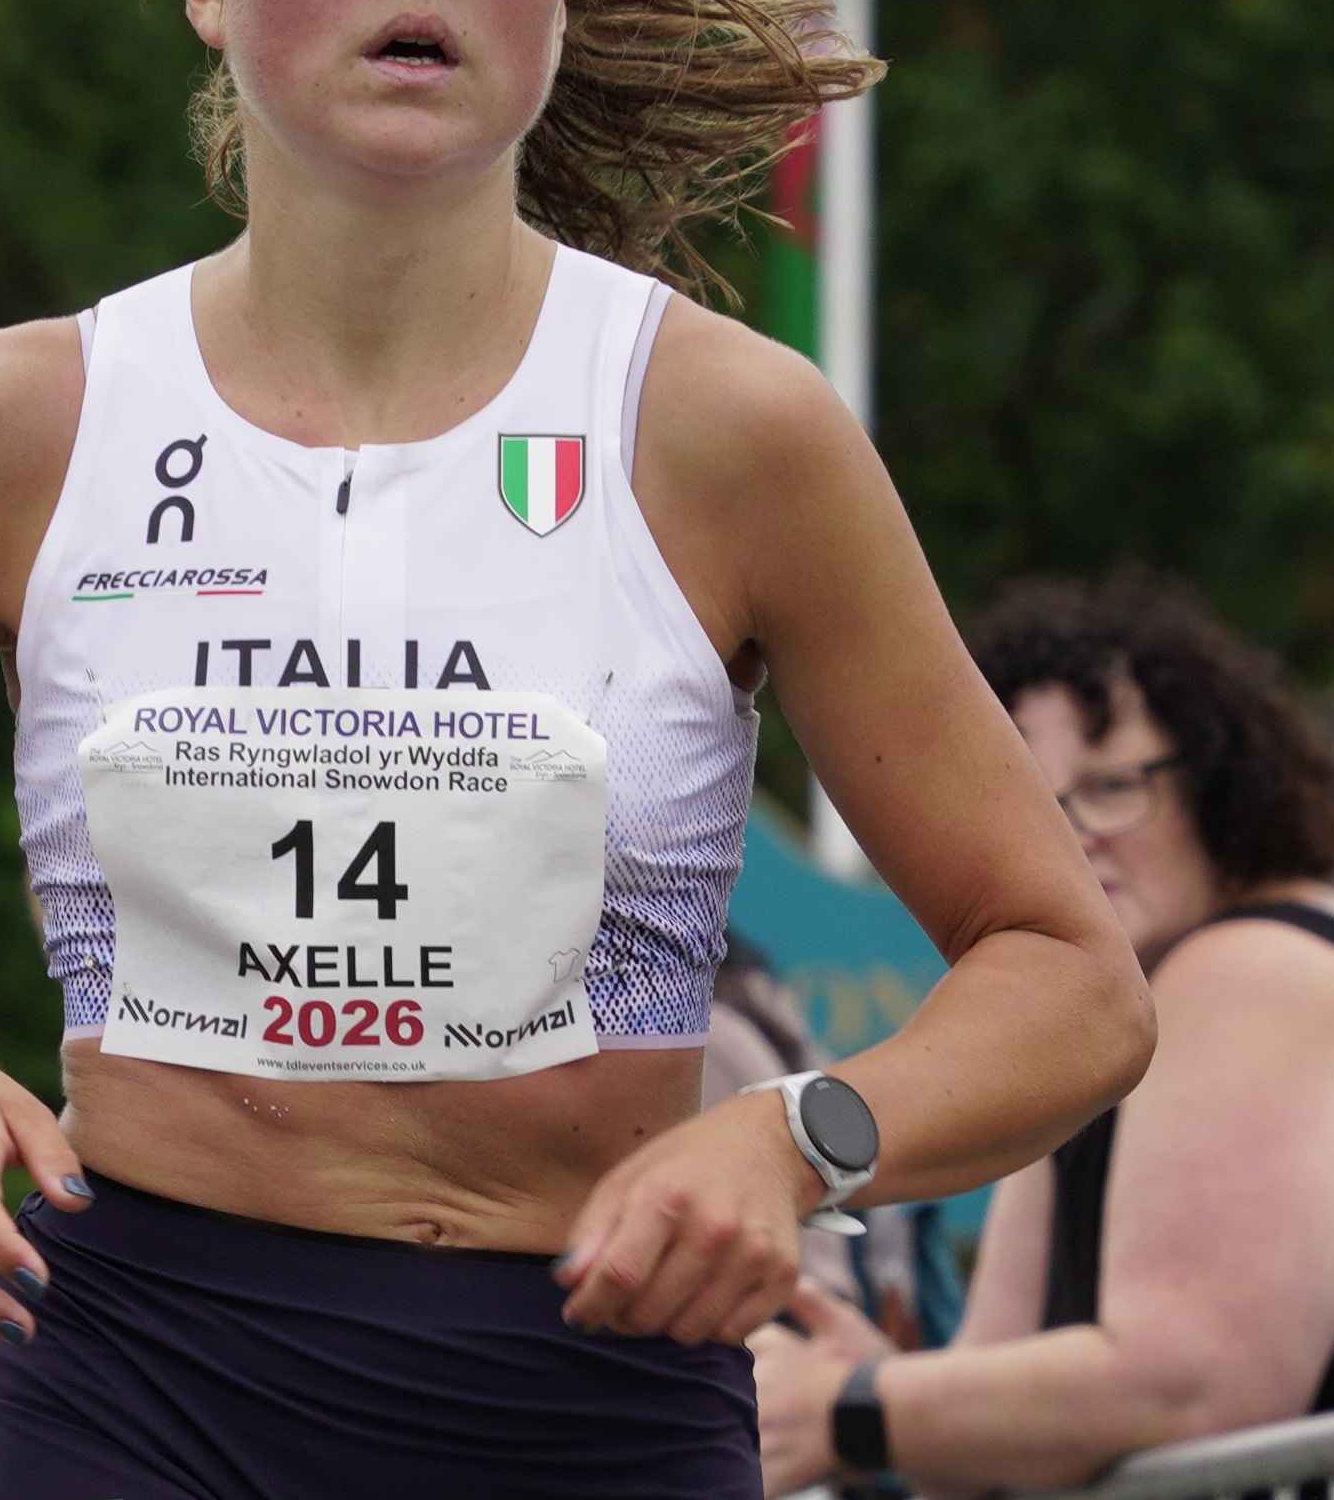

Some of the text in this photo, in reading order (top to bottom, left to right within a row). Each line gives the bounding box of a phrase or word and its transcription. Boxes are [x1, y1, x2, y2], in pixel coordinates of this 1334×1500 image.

[77, 568, 268, 591] FRECCIAROSSA
[194, 638, 492, 691] ITALIA
[134, 706, 550, 740] ROYAL VICTORIA HOTEL
[175, 740, 499, 771] Ras Ryngwladol yr Wyddfa
[166, 766, 316, 788] International
[325, 768, 440, 790] Snowdon
[449, 771, 508, 792] Race
[271, 818, 409, 921] 14
[238, 942, 454, 988] AXELLE
[262, 995, 425, 1048] 2026
[257, 1057, 427, 1072] www.tdleventservices.co.uk
